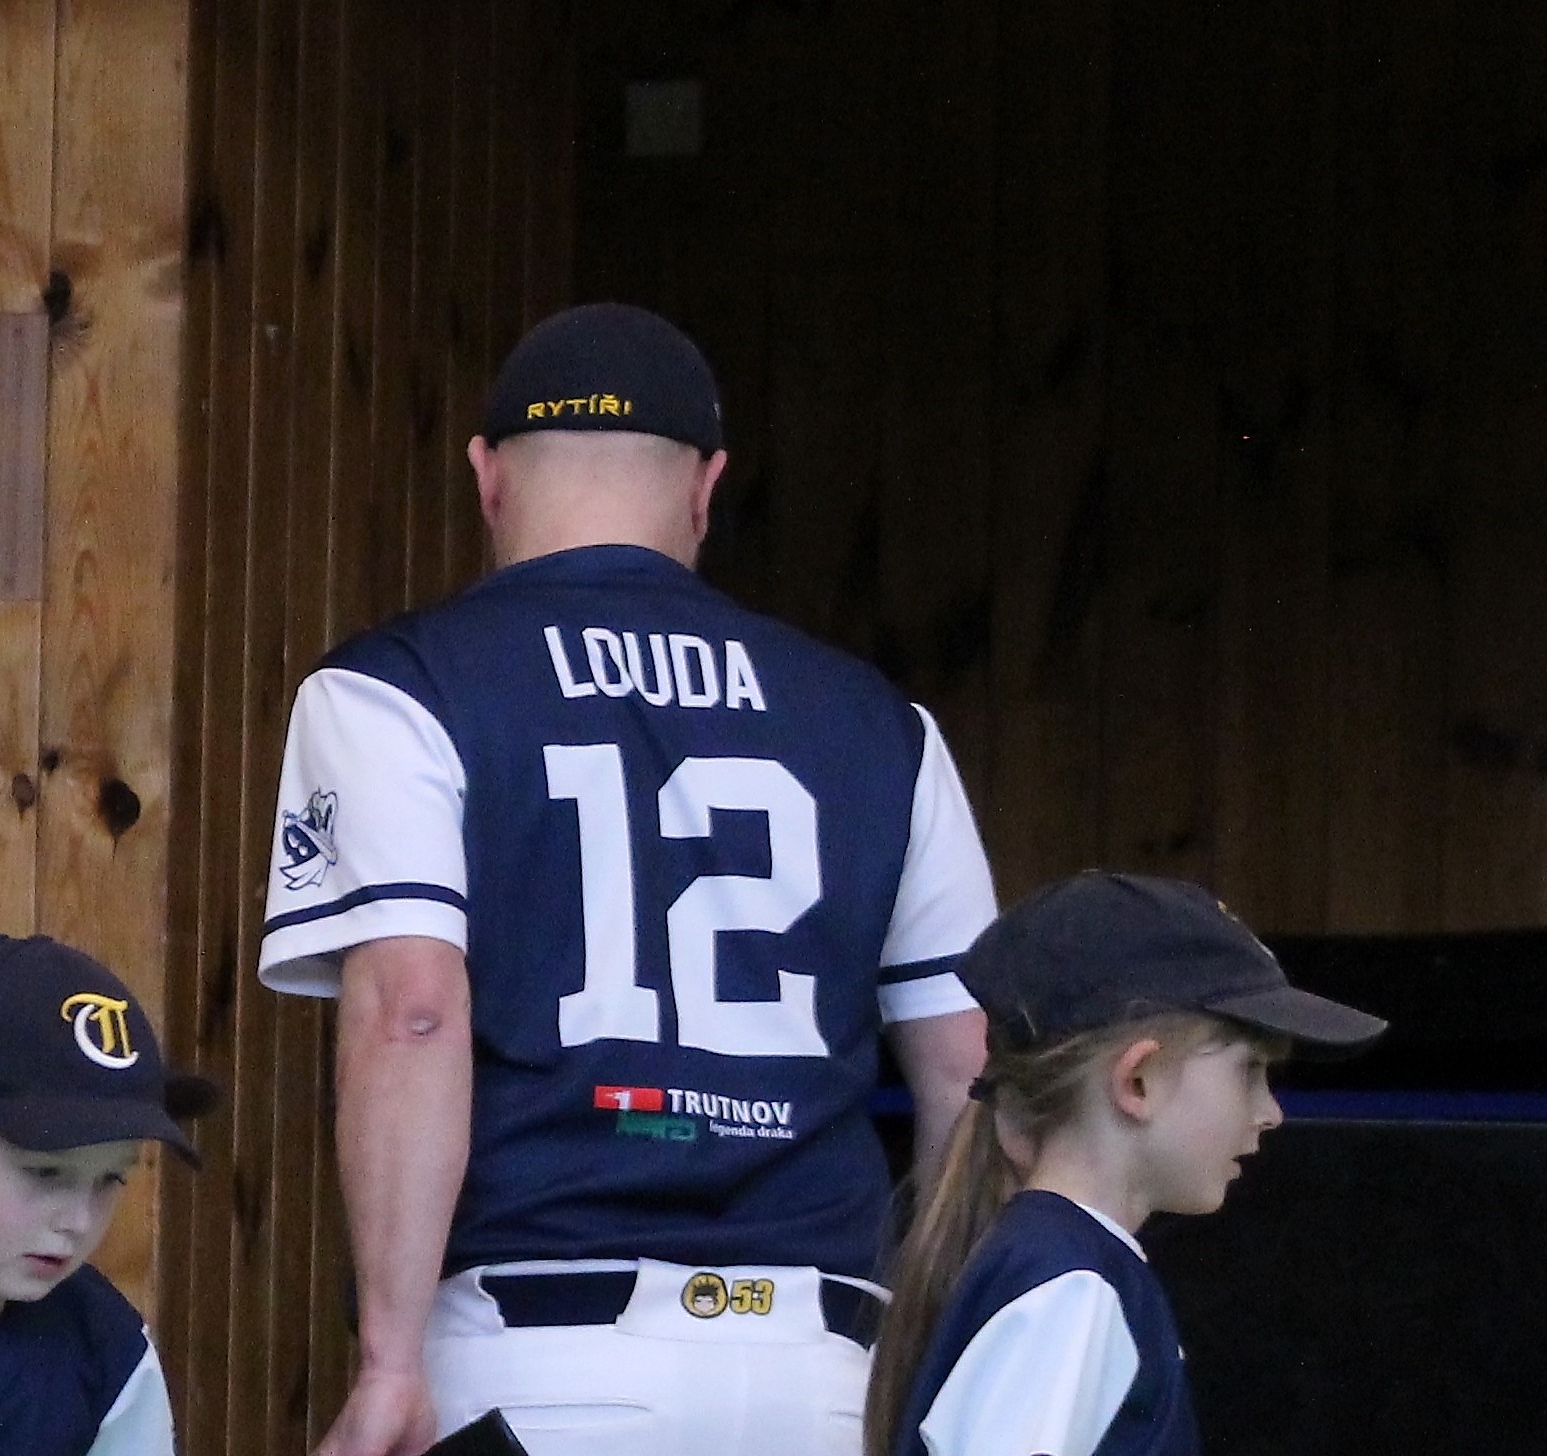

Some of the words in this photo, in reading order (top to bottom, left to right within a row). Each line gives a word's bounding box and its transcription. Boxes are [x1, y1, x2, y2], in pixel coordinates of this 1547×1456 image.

[543, 625, 767, 712] LOUDA
[542, 743, 830, 1058] 12
[667, 1088, 793, 1125] TRUTNOV
[730, 1279, 774, 1315] 53
